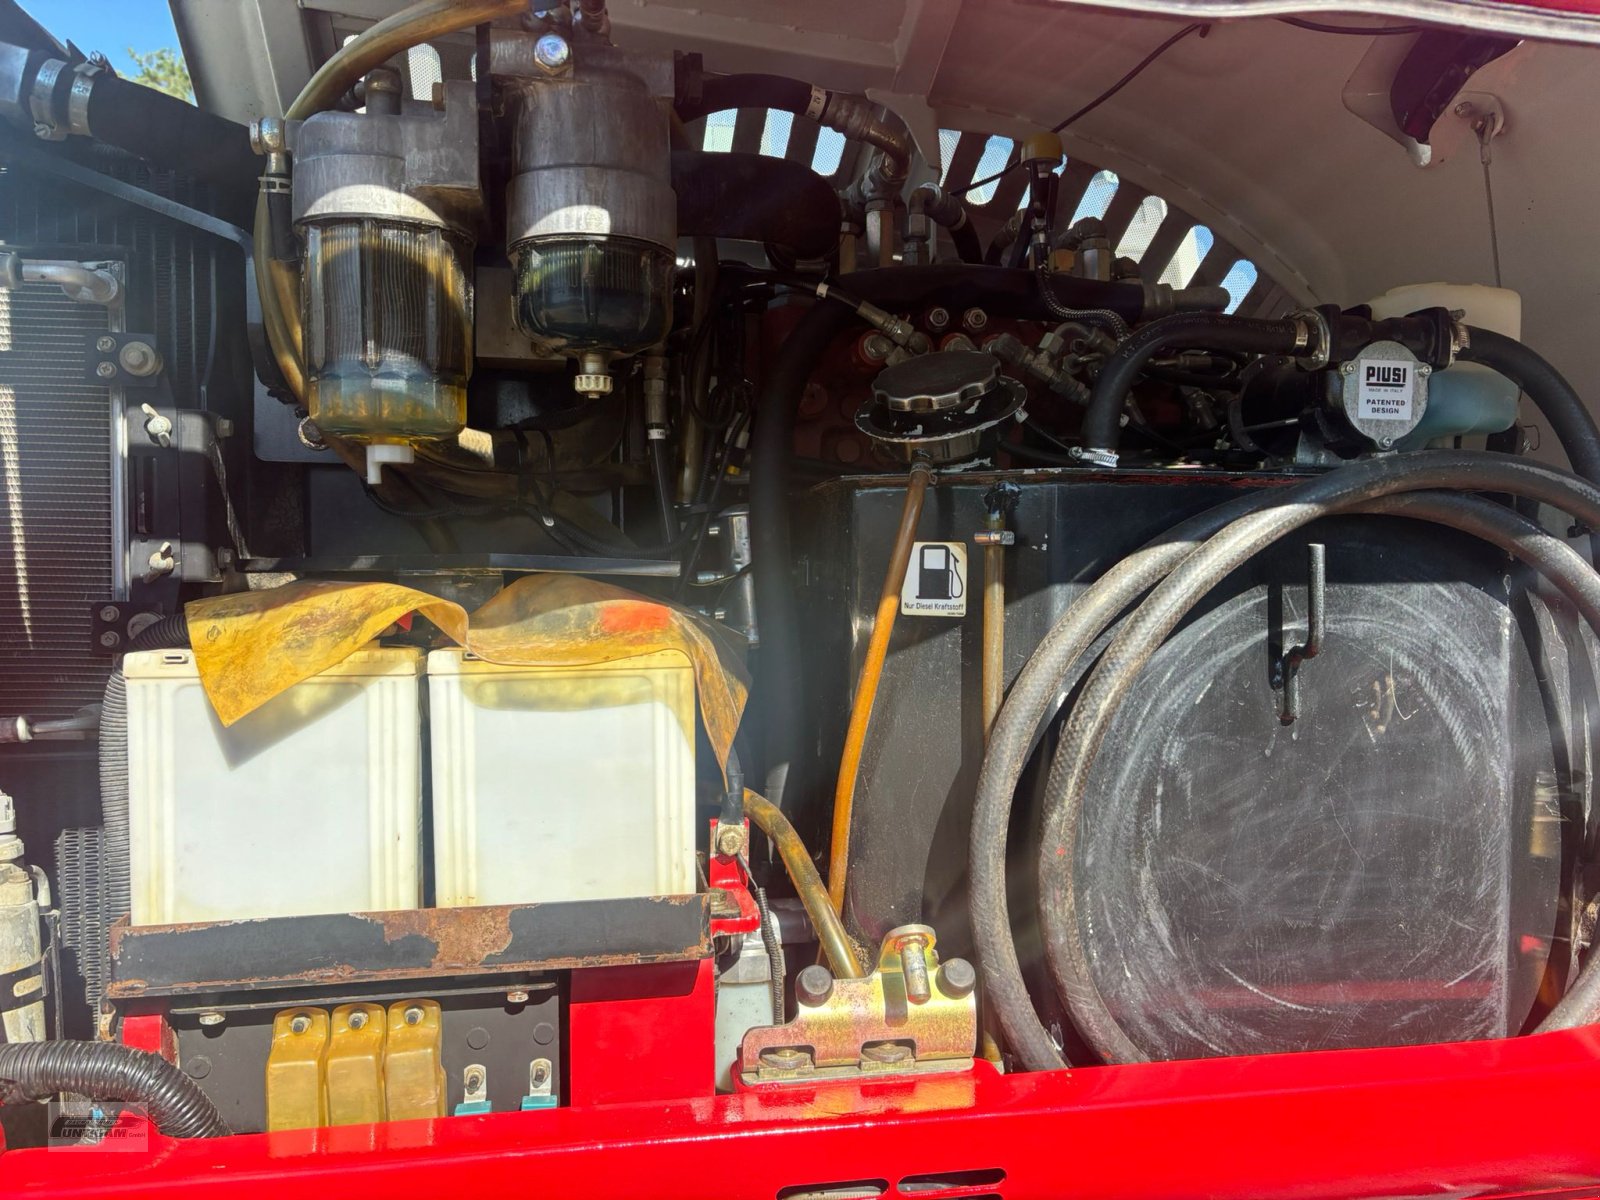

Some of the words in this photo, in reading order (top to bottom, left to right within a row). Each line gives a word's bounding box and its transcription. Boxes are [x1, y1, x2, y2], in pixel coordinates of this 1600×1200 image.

[1366, 366, 1406, 383] PIUSI
[916, 602, 933, 610] Diesel
[935, 602, 964, 610] Kraftstoff
